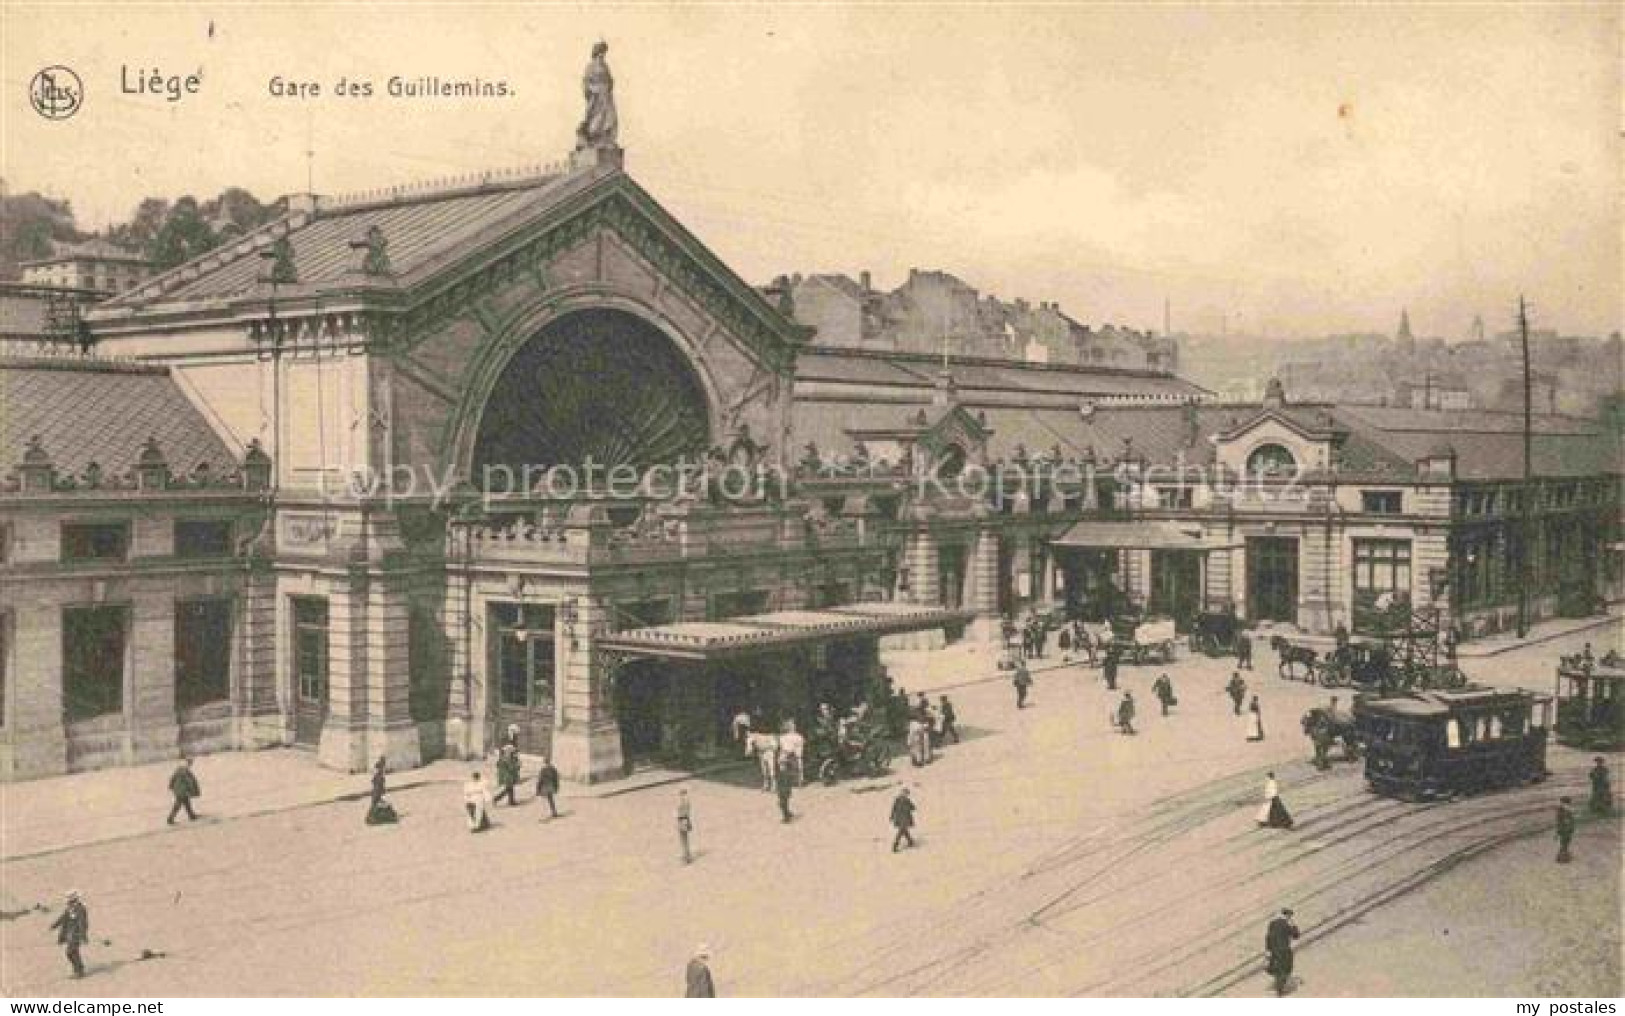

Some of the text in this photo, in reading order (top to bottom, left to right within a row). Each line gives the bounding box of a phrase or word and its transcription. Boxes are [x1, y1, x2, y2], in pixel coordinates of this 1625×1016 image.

[268, 76, 516, 99] Gare des Guillemins.
